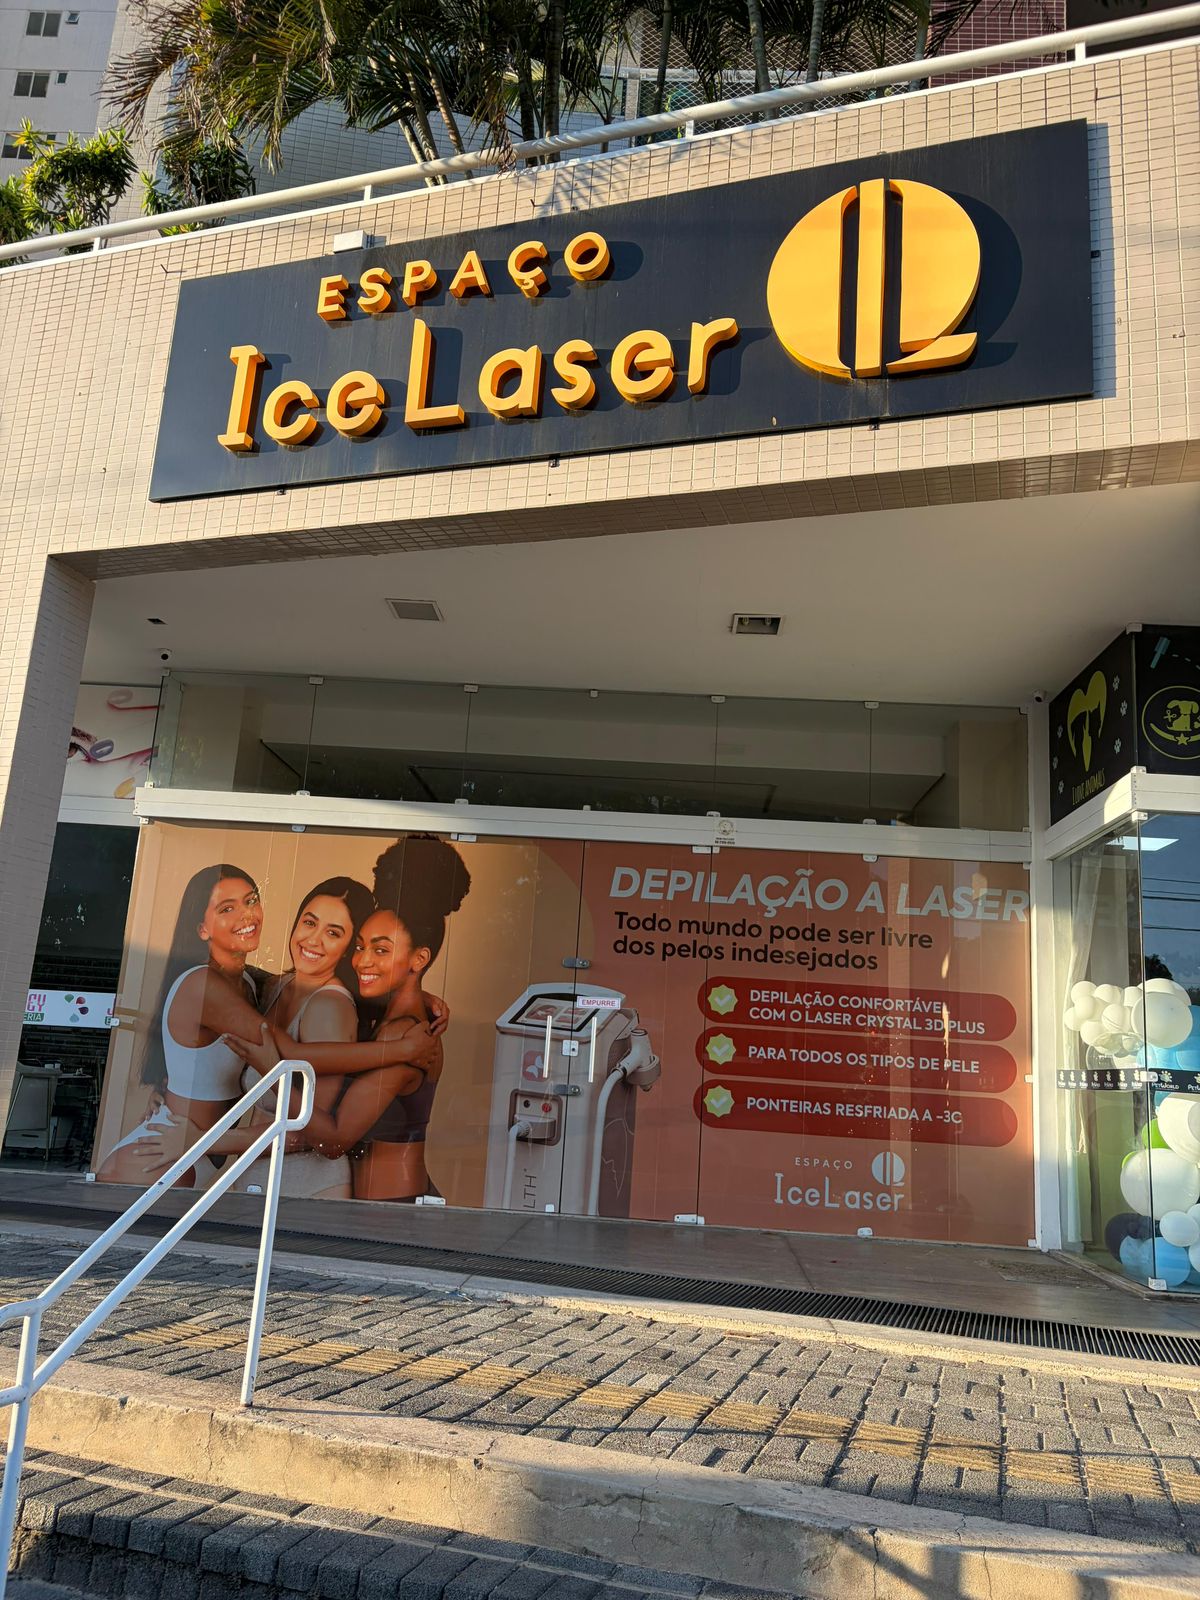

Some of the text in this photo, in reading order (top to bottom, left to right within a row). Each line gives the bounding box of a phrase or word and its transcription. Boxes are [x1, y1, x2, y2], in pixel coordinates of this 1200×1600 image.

[316, 230, 611, 321] ESPAÇO
[217, 316, 740, 452] IceLaser
[609, 866, 1031, 922] DEPILAÇÃO A LASER
[614, 911, 933, 948] Todo mundo pode ser livre
[613, 935, 878, 971] dos pelos indesejados
[581, 999, 616, 1007] EMPURRE
[750, 989, 835, 1009] DEPILAÇÃO
[749, 1007, 985, 1035] COM O LASER CRYSTAL 3D PLUS
[748, 1045, 980, 1074] PARA TODOS OS TIPOS DE PELE
[747, 1097, 962, 1124] PONTEIRAS RESFRIADA A -3C
[795, 1157, 853, 1170] ESPAÇO
[774, 1172, 905, 1212] IceLaser
